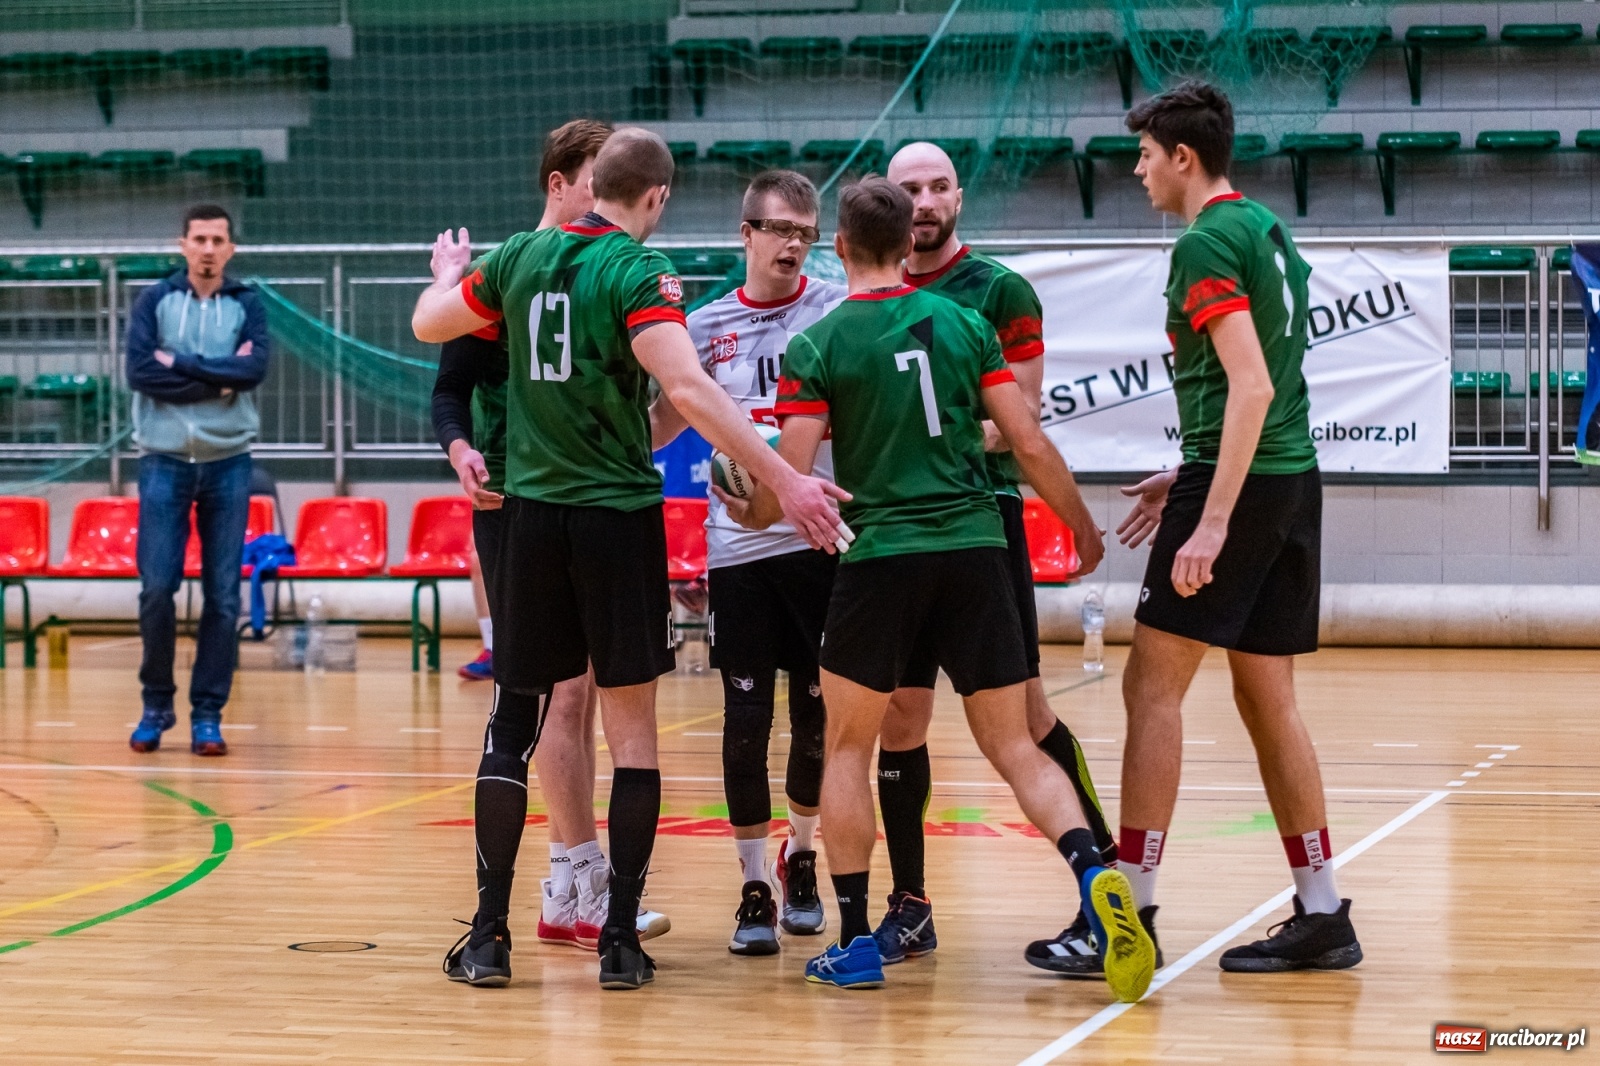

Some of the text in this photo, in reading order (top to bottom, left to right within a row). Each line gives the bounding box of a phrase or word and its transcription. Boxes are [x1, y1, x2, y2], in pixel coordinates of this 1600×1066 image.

[528, 290, 572, 382] 13
[1109, 359, 1149, 397] W
[1306, 280, 1410, 350] DKU!
[893, 350, 942, 437] 7
[729, 459, 749, 498] molten
[1140, 837, 1160, 874] KIPSTA
[1305, 837, 1324, 873] KIPSTA
